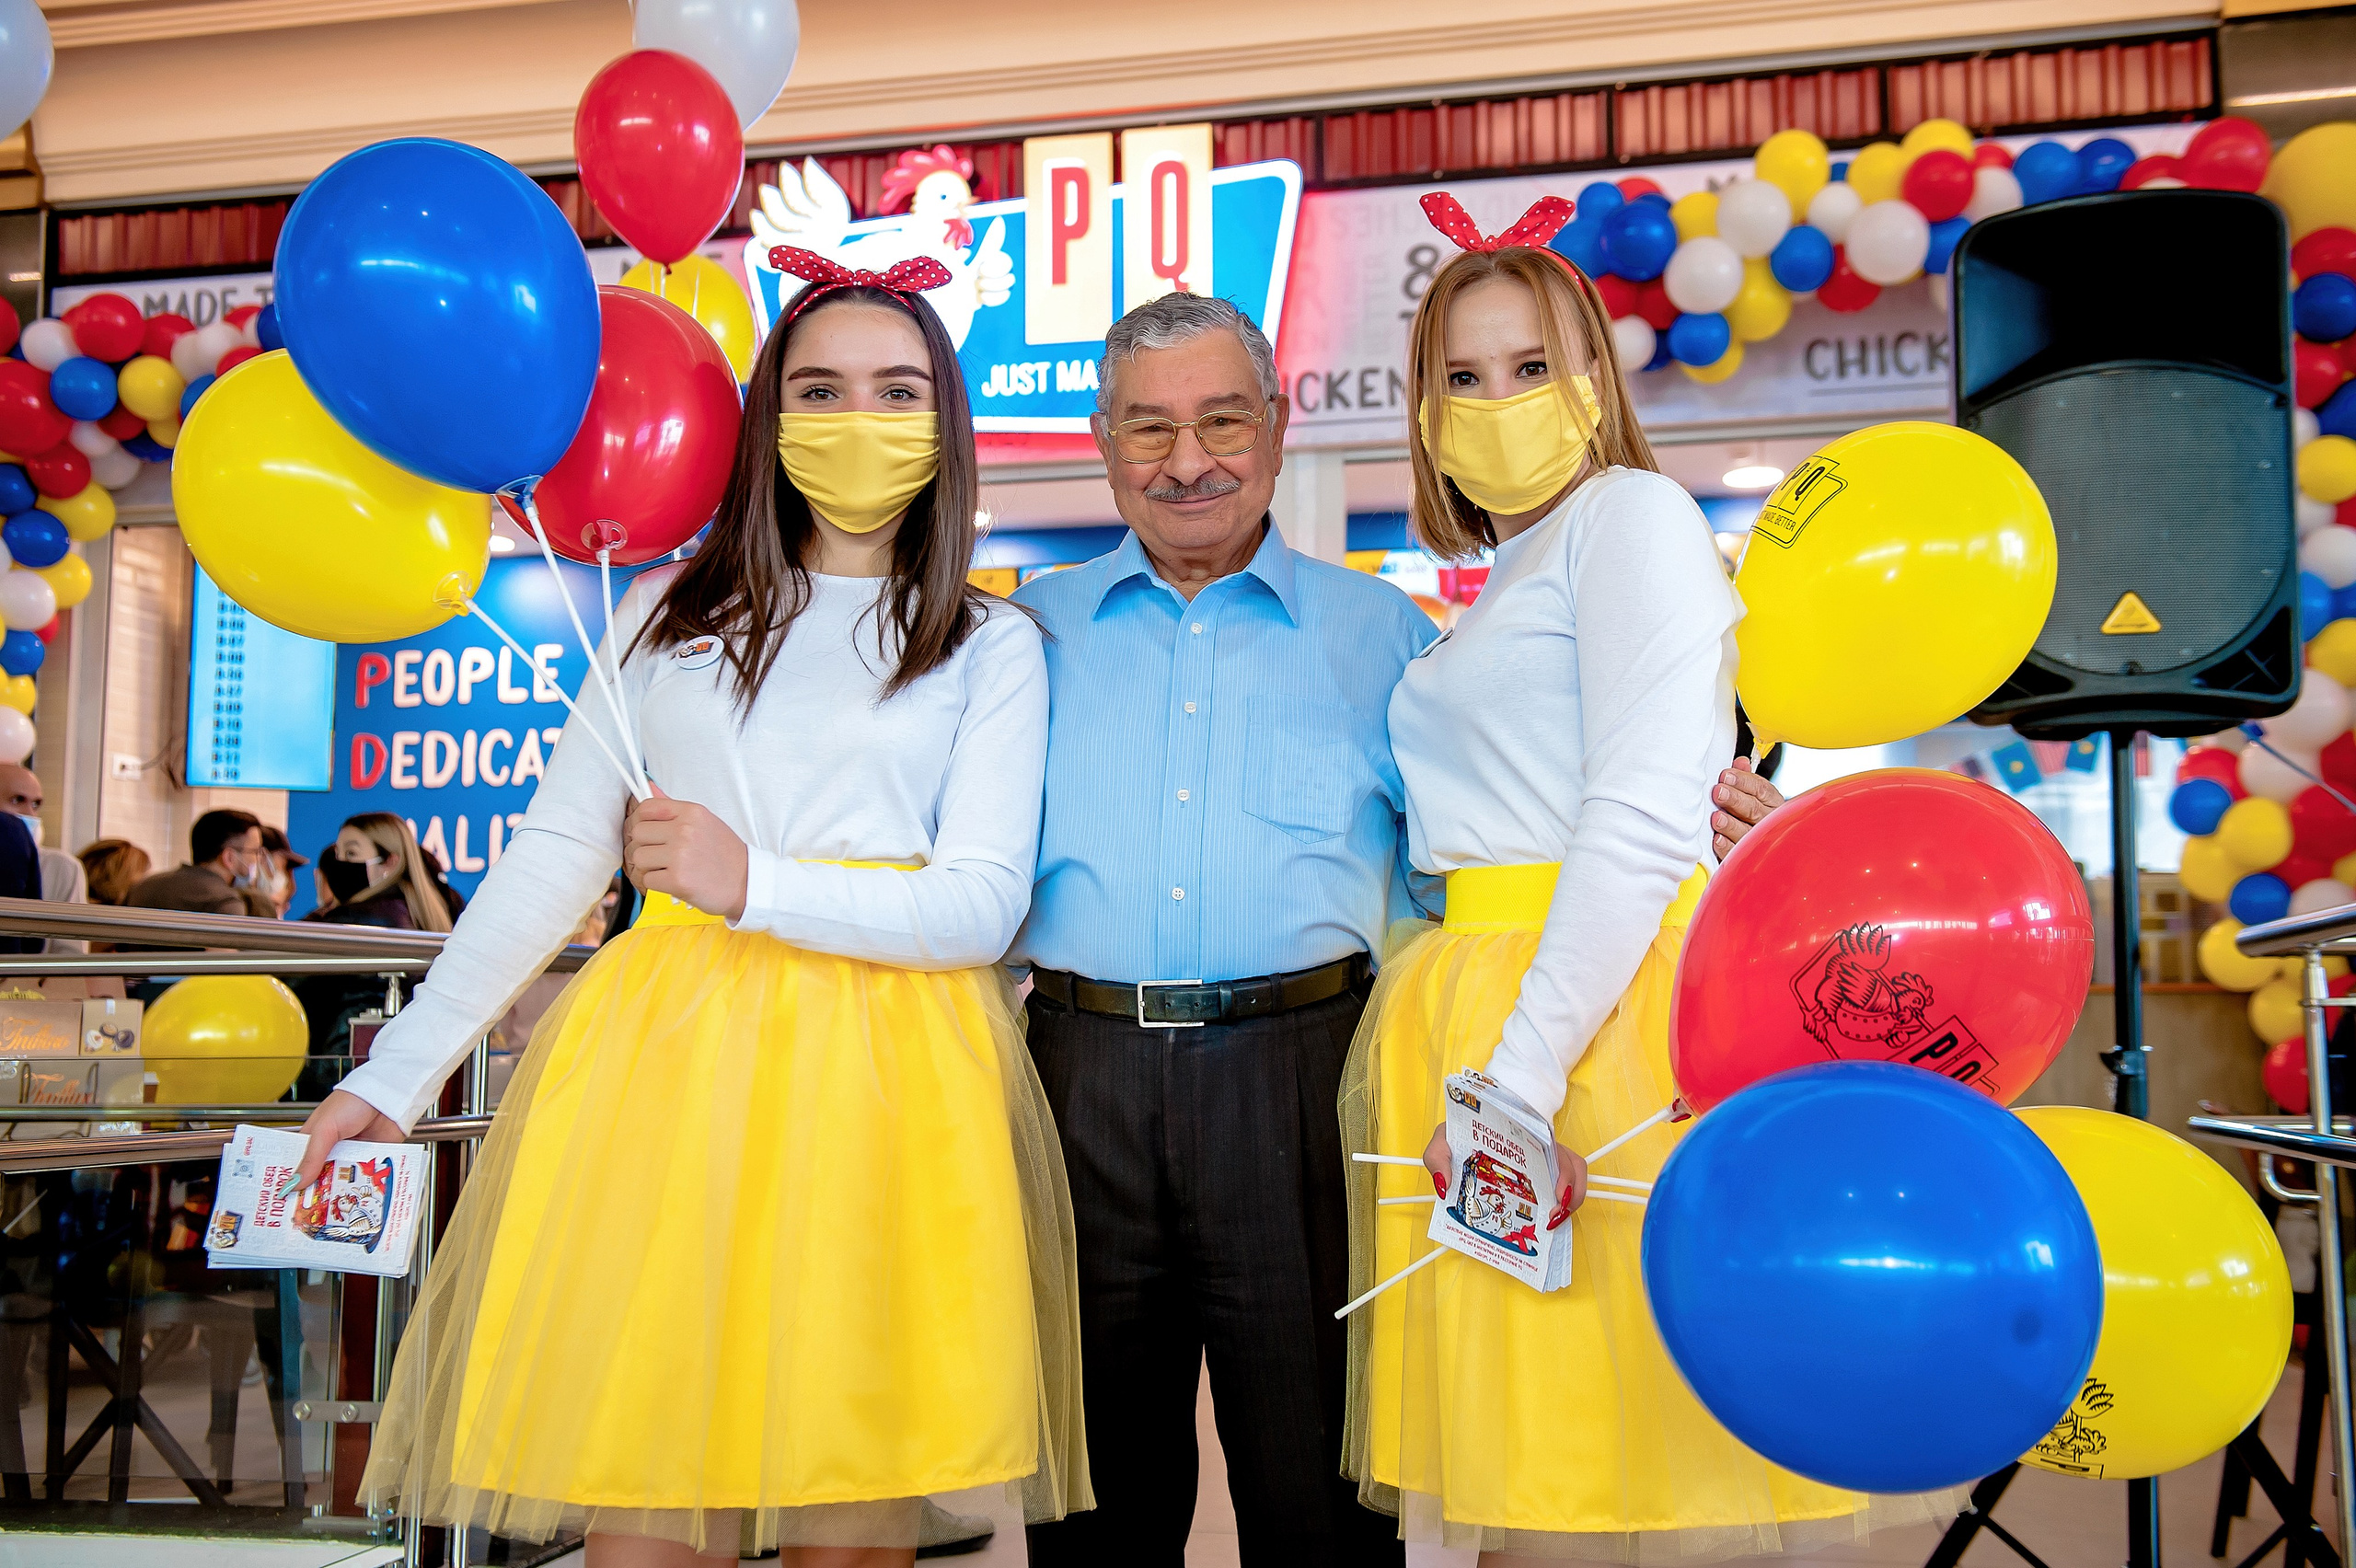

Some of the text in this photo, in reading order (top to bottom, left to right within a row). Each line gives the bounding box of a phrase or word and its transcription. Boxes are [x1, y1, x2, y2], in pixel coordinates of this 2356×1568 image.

[981, 362, 1052, 398] JUST
[1773, 514, 1796, 532] BETTER
[355, 643, 564, 709] PEOPLE
[1483, 1135, 1527, 1169] ПОДАРОК
[1506, 1139, 1525, 1157] ОБЕД
[262, 1166, 276, 1188] ОБЕД
[270, 1166, 293, 1216] ПОДРОК
